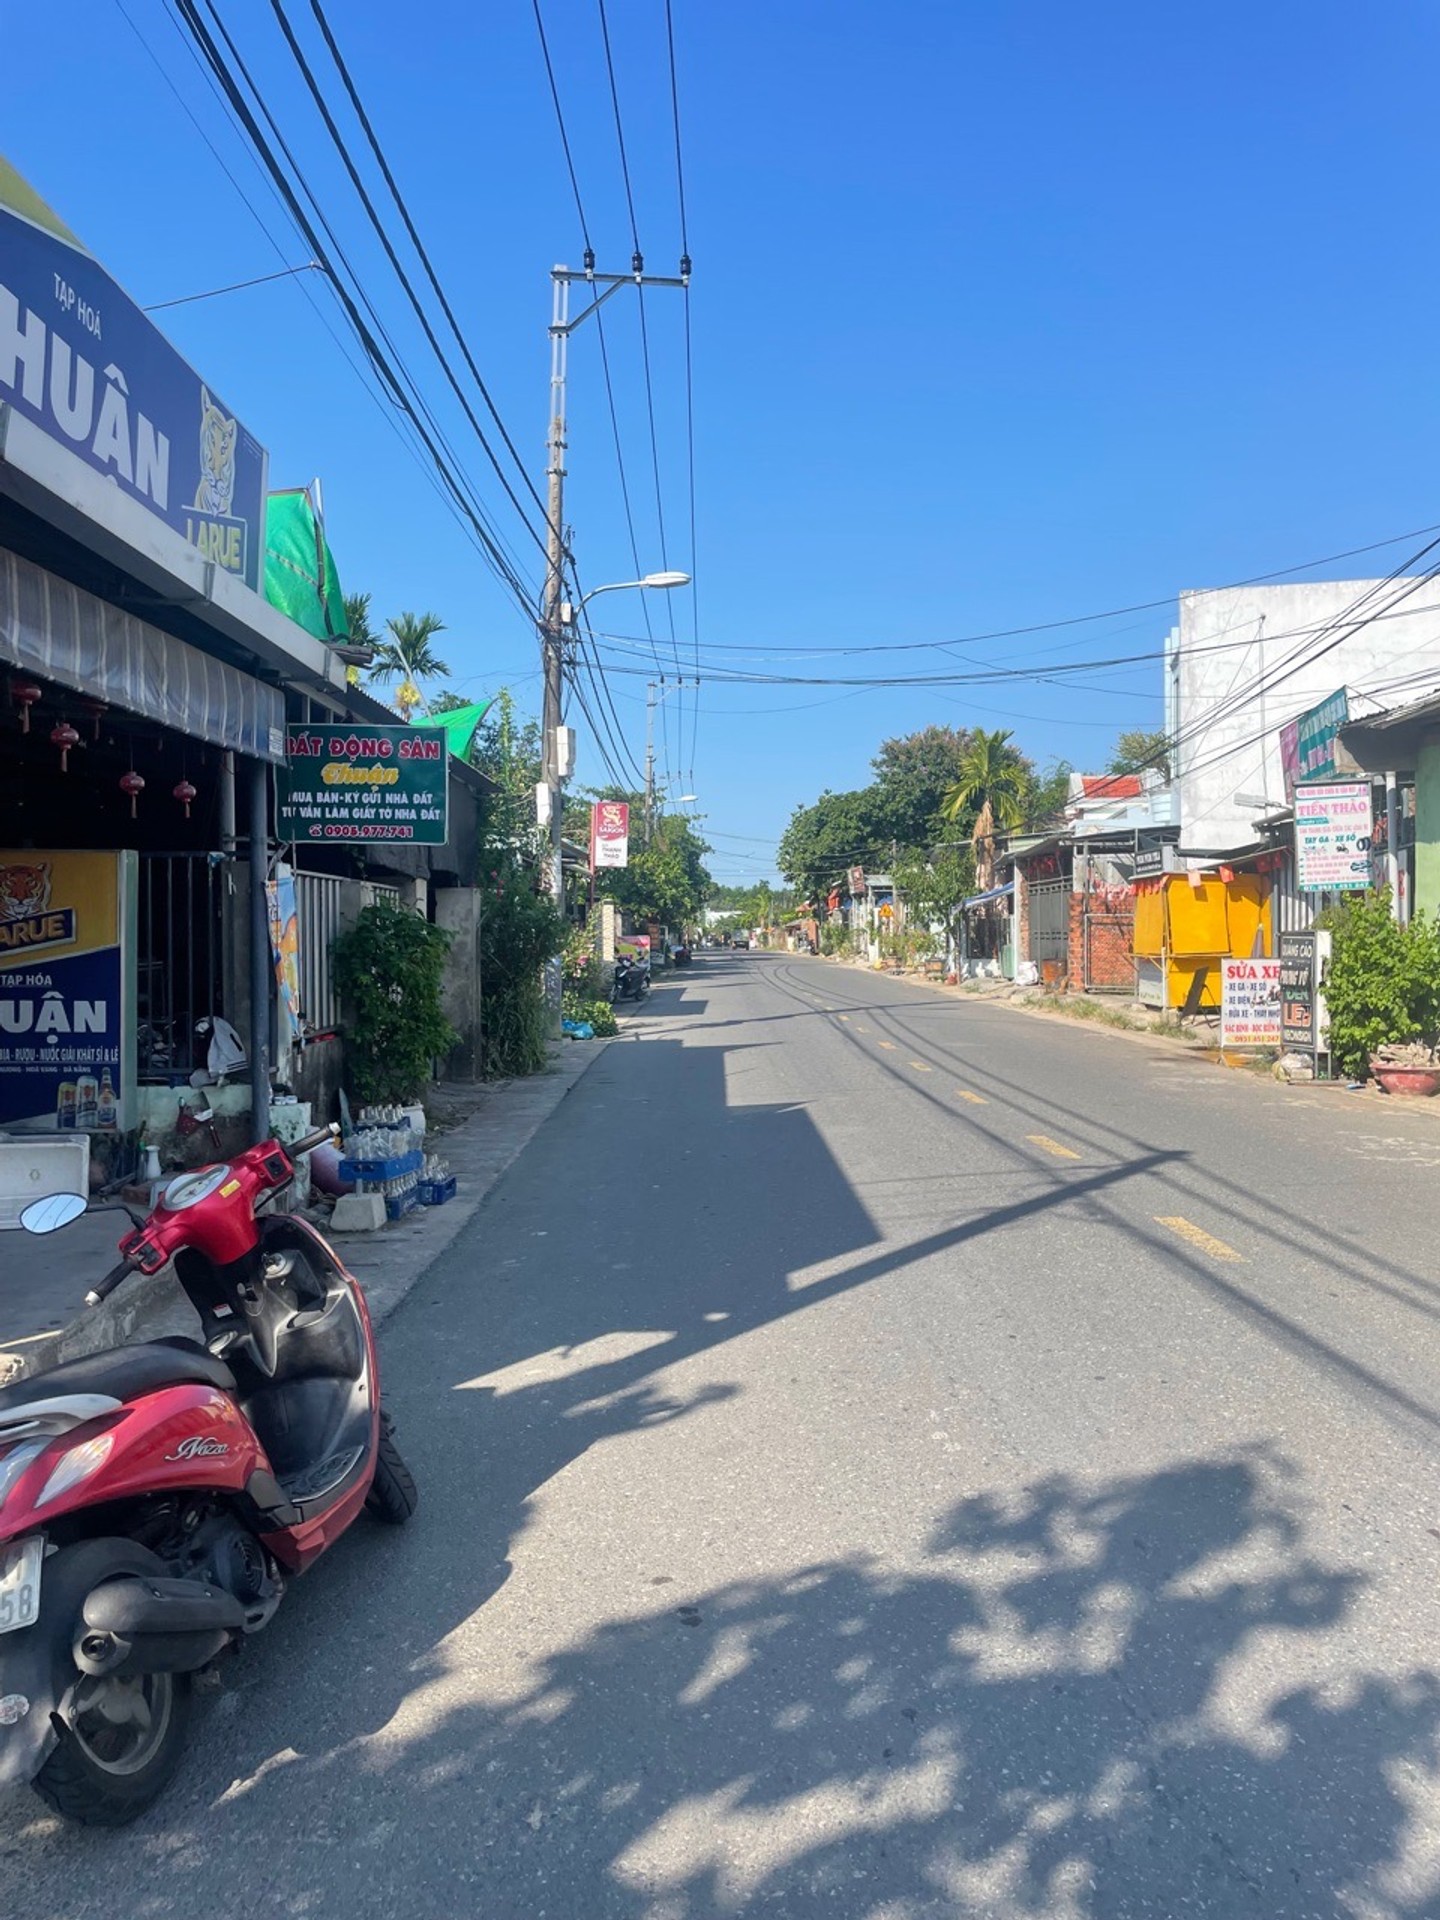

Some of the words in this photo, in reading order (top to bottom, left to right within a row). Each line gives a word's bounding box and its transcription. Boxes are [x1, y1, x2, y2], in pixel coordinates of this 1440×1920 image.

[53, 272, 76, 313] TẠP
[77, 300, 102, 341] HOÁ
[329, 733, 393, 761] ĐỘNG
[398, 735, 441, 759] SẢN
[325, 825, 413, 837] 0905.977.741
[1227, 960, 1258, 979] SỬA
[1, 974, 24, 988] TẠP
[26, 972, 53, 986] HÓA
[1228, 983, 1236, 991] XE
[1250, 983, 1258, 991] XE
[1228, 996, 1236, 1004] XE
[1, 1584, 33, 1624] 58
